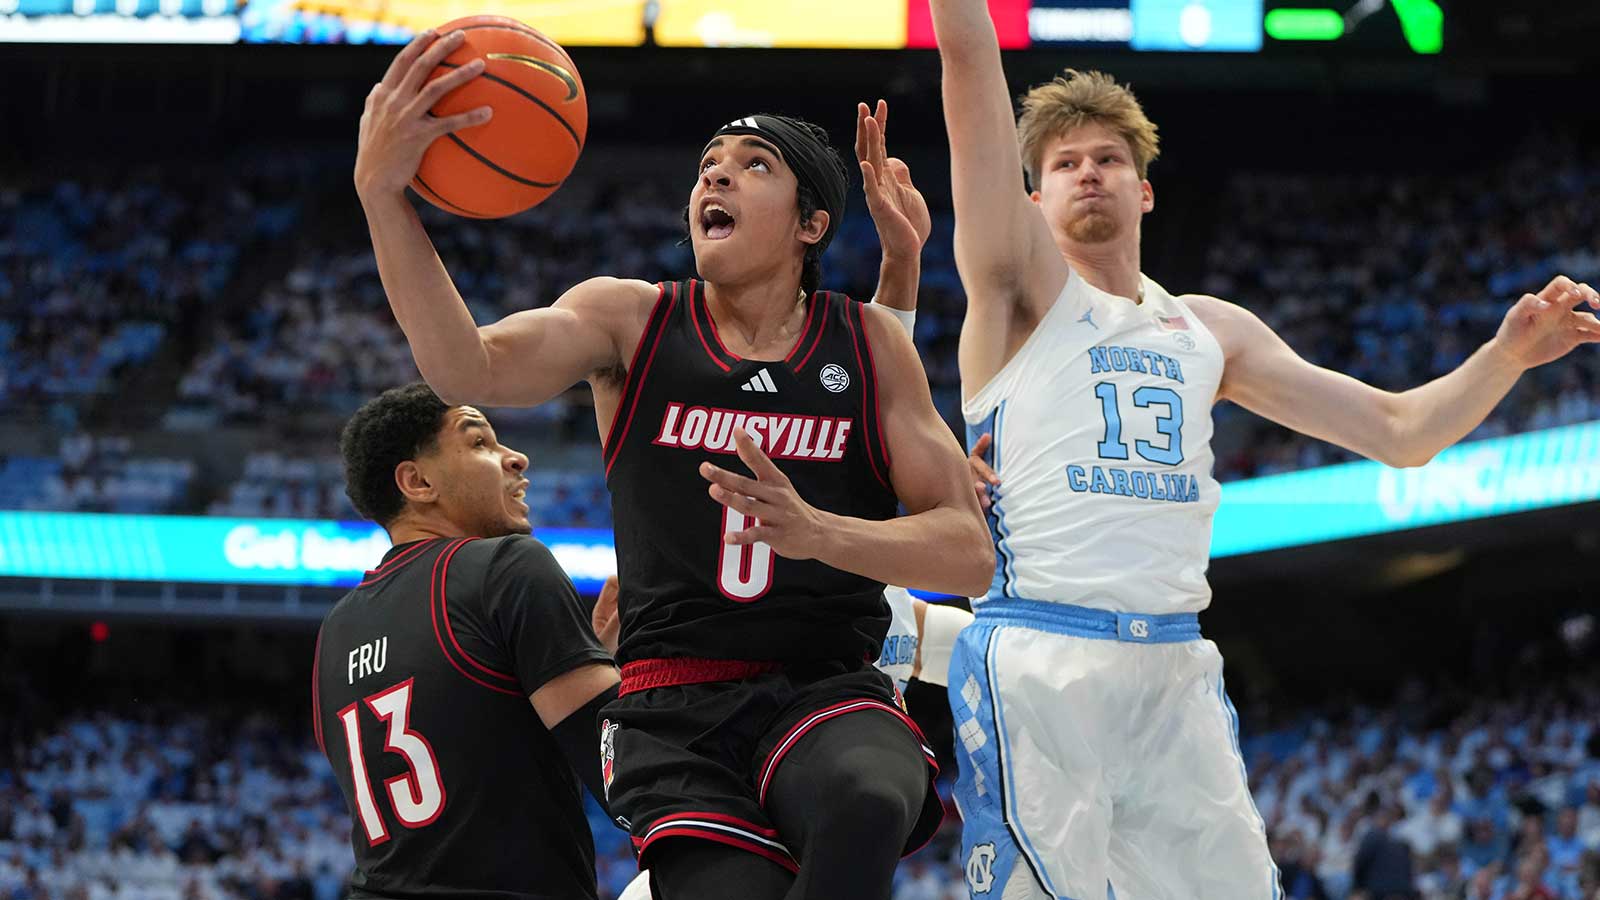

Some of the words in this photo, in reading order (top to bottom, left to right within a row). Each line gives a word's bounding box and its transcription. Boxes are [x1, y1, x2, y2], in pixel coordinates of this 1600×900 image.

[1088, 345, 1185, 384] NORTH
[651, 401, 853, 462] LOUISVILLE
[1094, 381, 1185, 466] 13
[1065, 464, 1200, 503] CAROLINA
[348, 636, 388, 685] FRU
[336, 676, 447, 848] 13
